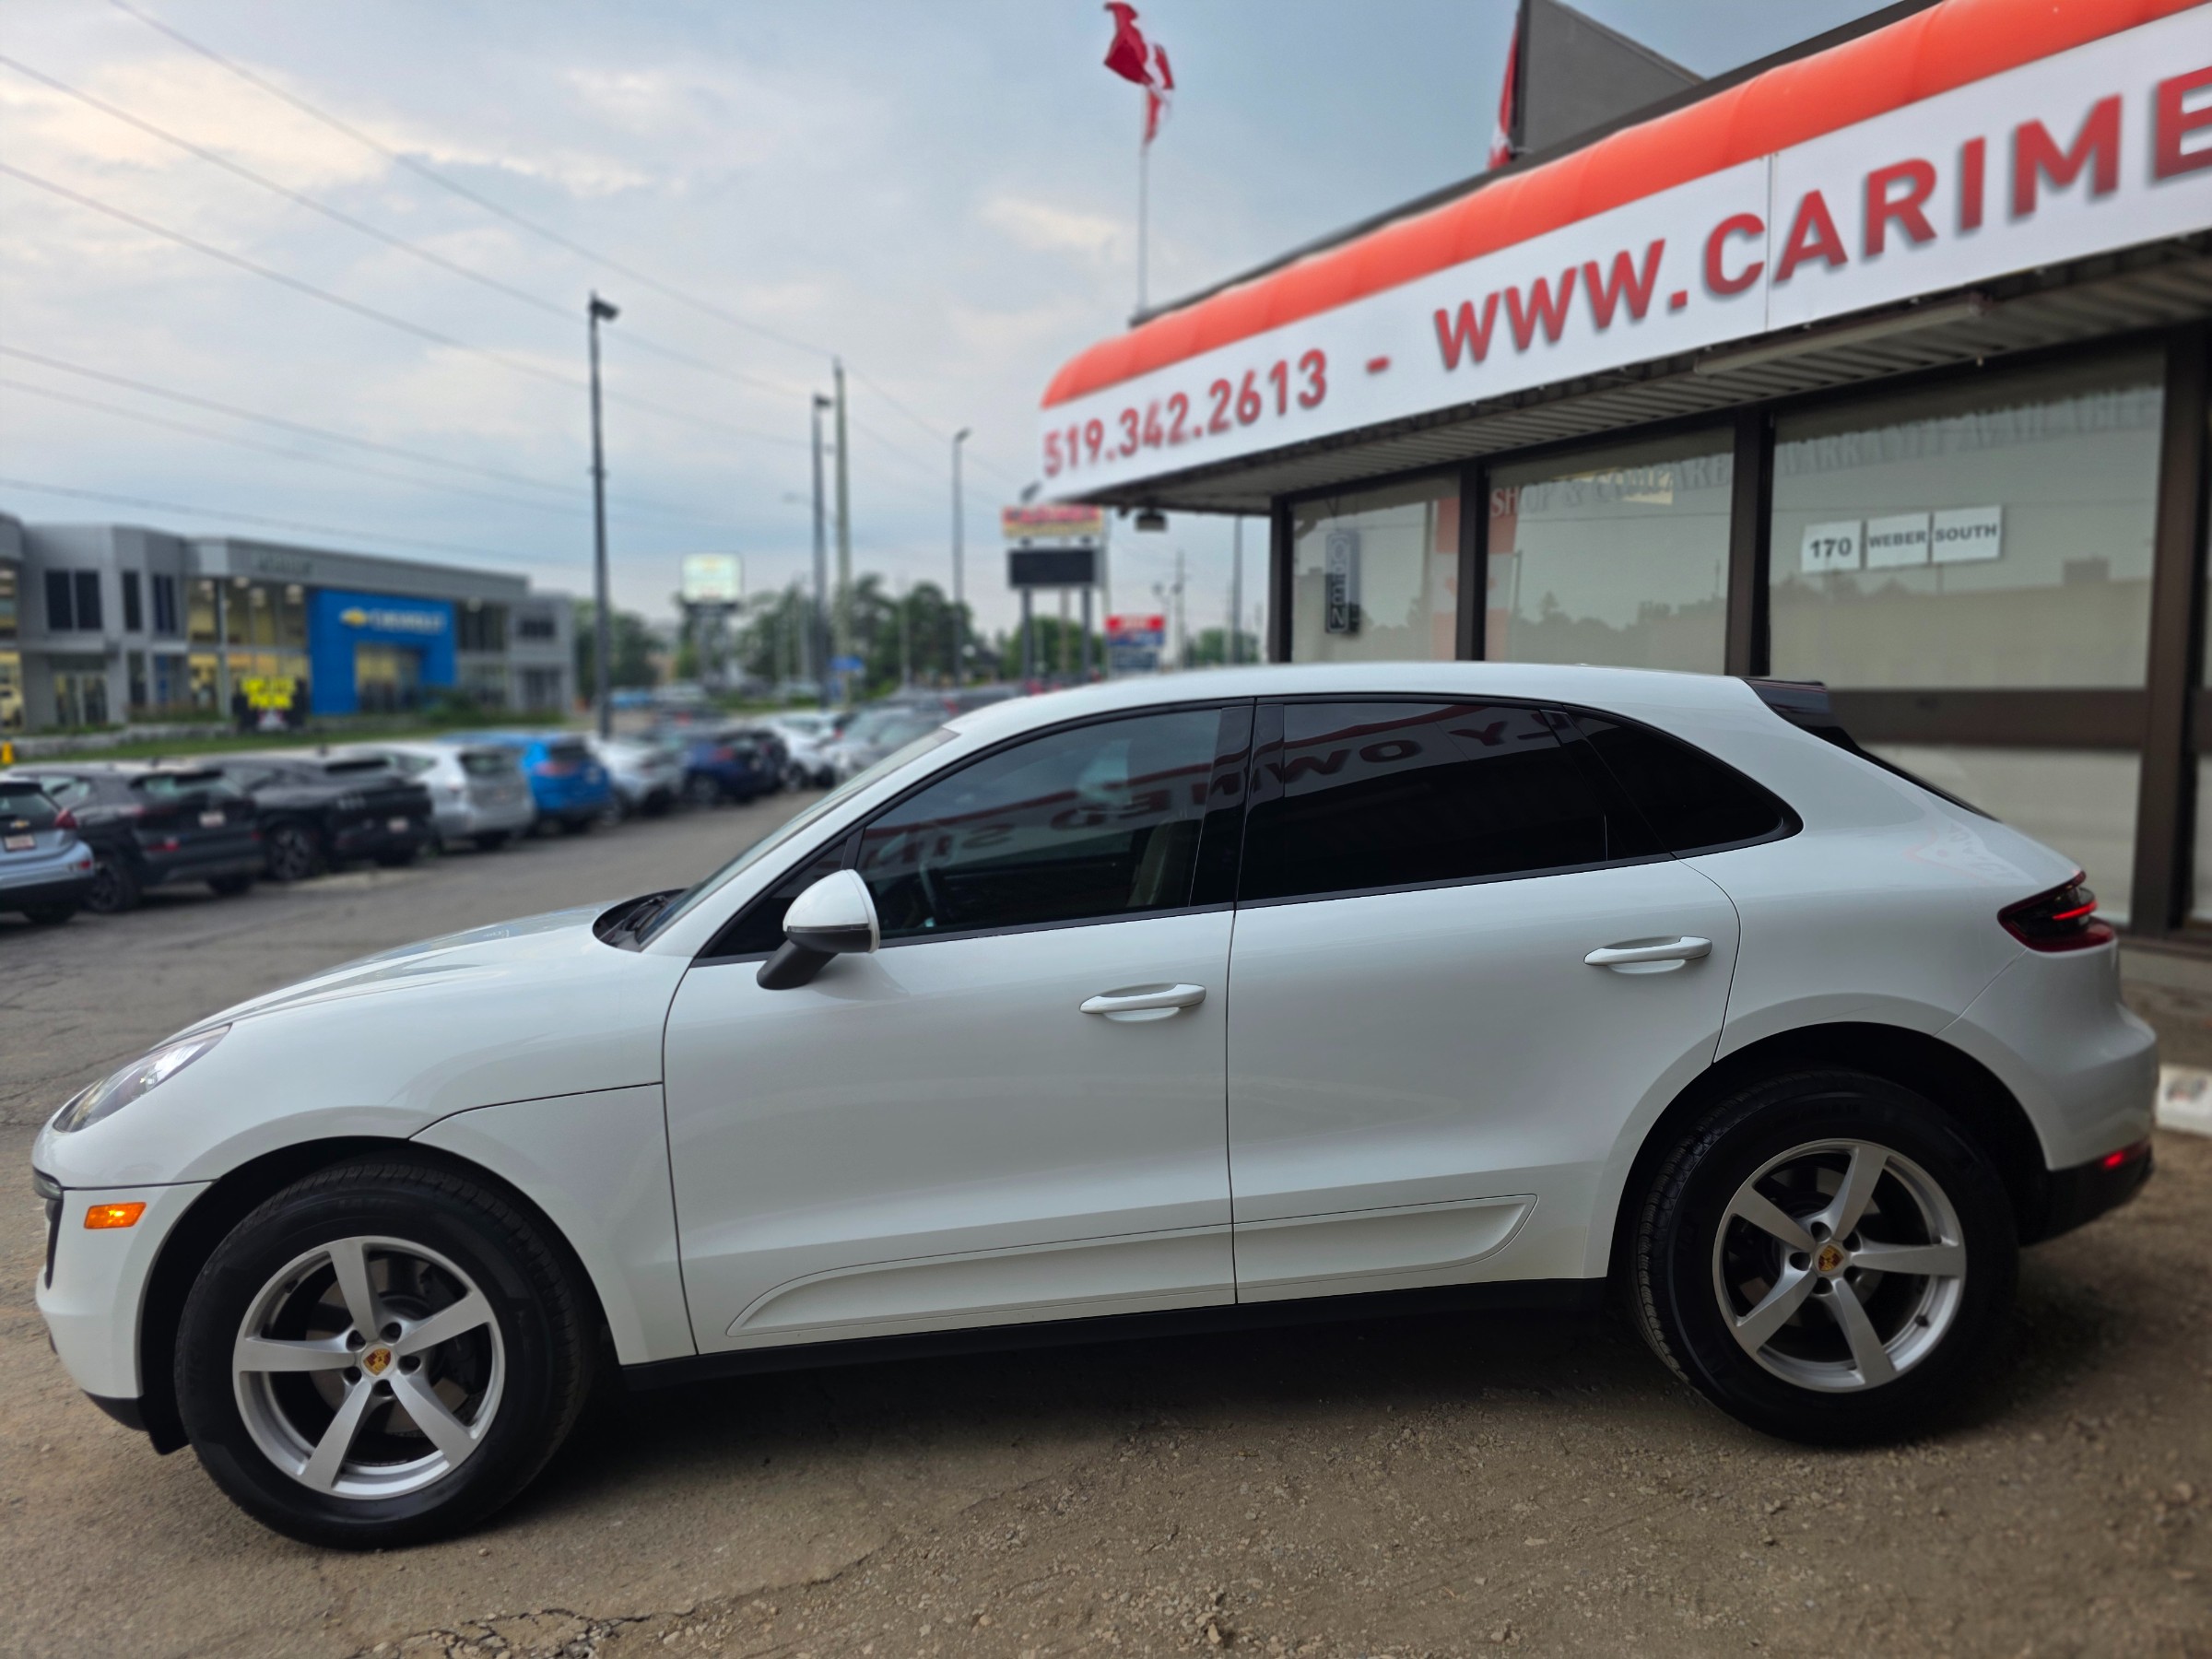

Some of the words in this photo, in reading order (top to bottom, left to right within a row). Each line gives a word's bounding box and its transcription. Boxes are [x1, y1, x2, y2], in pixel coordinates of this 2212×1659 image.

[1043, 348, 1326, 477] 519.342.2613
[1434, 65, 2212, 371] WWW.CARIME
[1331, 540, 1347, 627] OPEN
[1809, 536, 1853, 559] 170
[1867, 530, 1927, 549] WEBER
[1935, 523, 1999, 542] SOUTH
